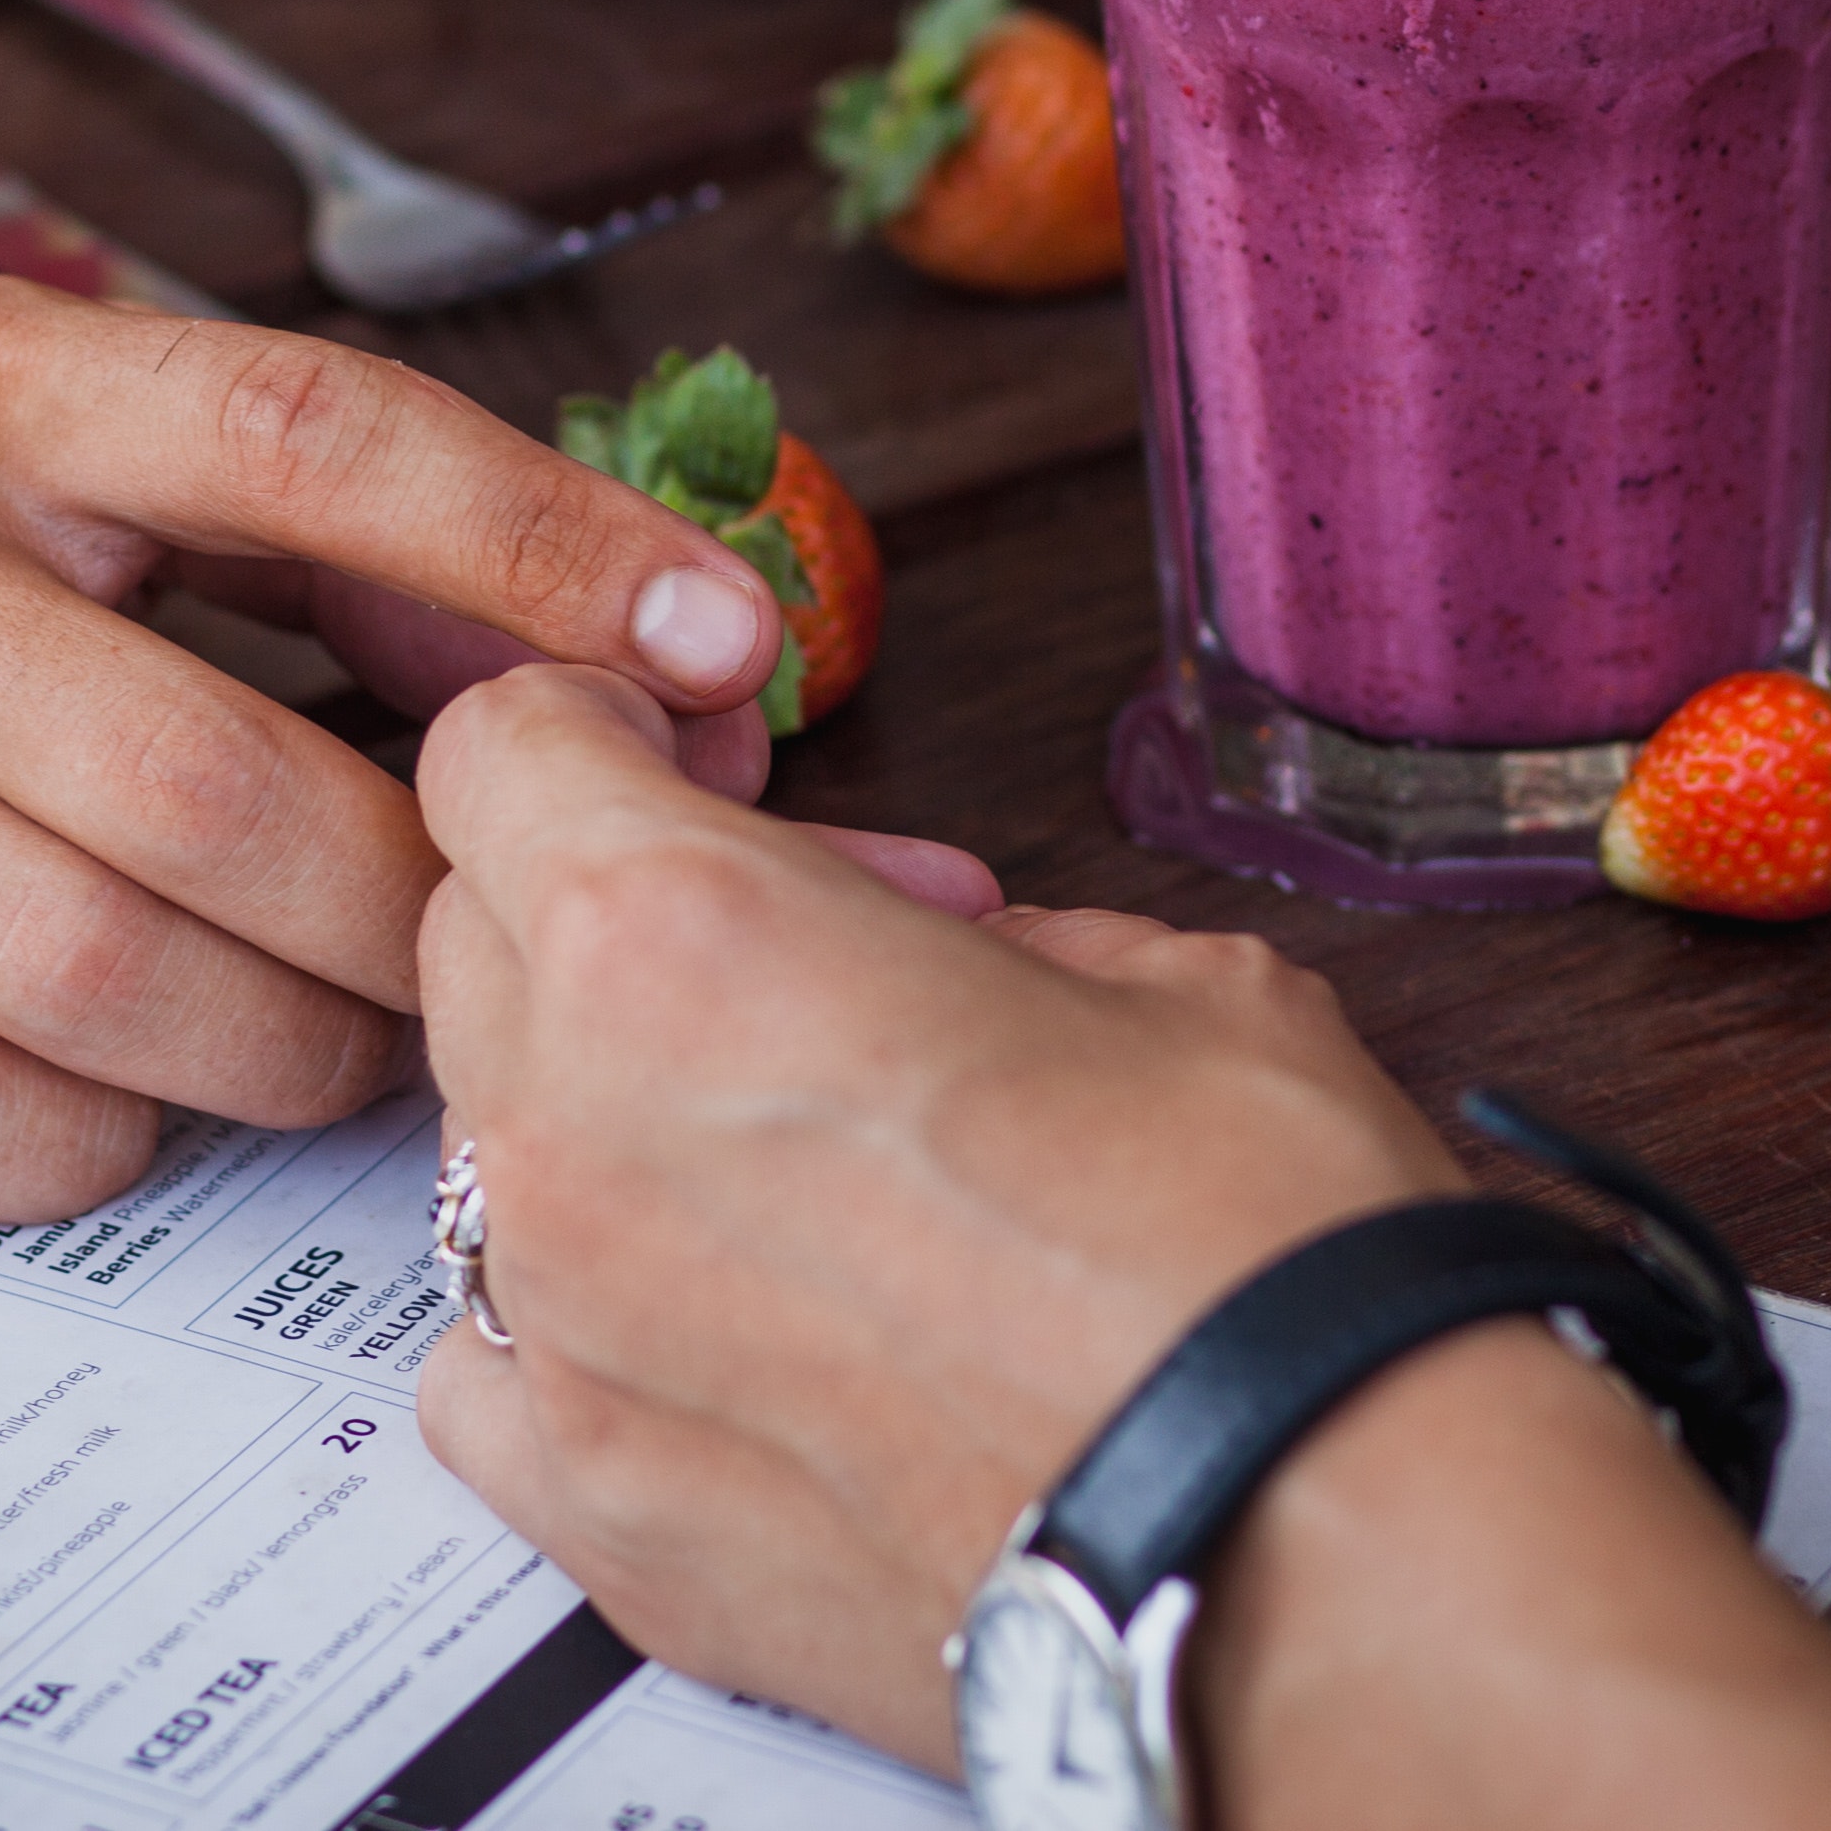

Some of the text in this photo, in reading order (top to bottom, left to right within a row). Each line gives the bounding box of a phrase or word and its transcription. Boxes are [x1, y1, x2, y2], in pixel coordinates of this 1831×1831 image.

[47, 1221, 123, 1275] Island
[113, 1149, 210, 1222] Pineapple
[85, 1136, 274, 1286] Berries Watermelon
[233, 1246, 345, 1330] JUICES
[279, 1280, 360, 1341] GREEN
[348, 1287, 447, 1360] YELLOW
[74, 1423, 123, 1458] milk
[320, 1418, 378, 1455] 20
[134, 1621, 196, 1670] green
[199, 1559, 265, 1609] black/
[256, 1472, 369, 1560] lemongrass
[294, 1594, 406, 1680] strawberry
[405, 1535, 466, 1584] peach
[124, 1657, 280, 1772] ICED TEA
